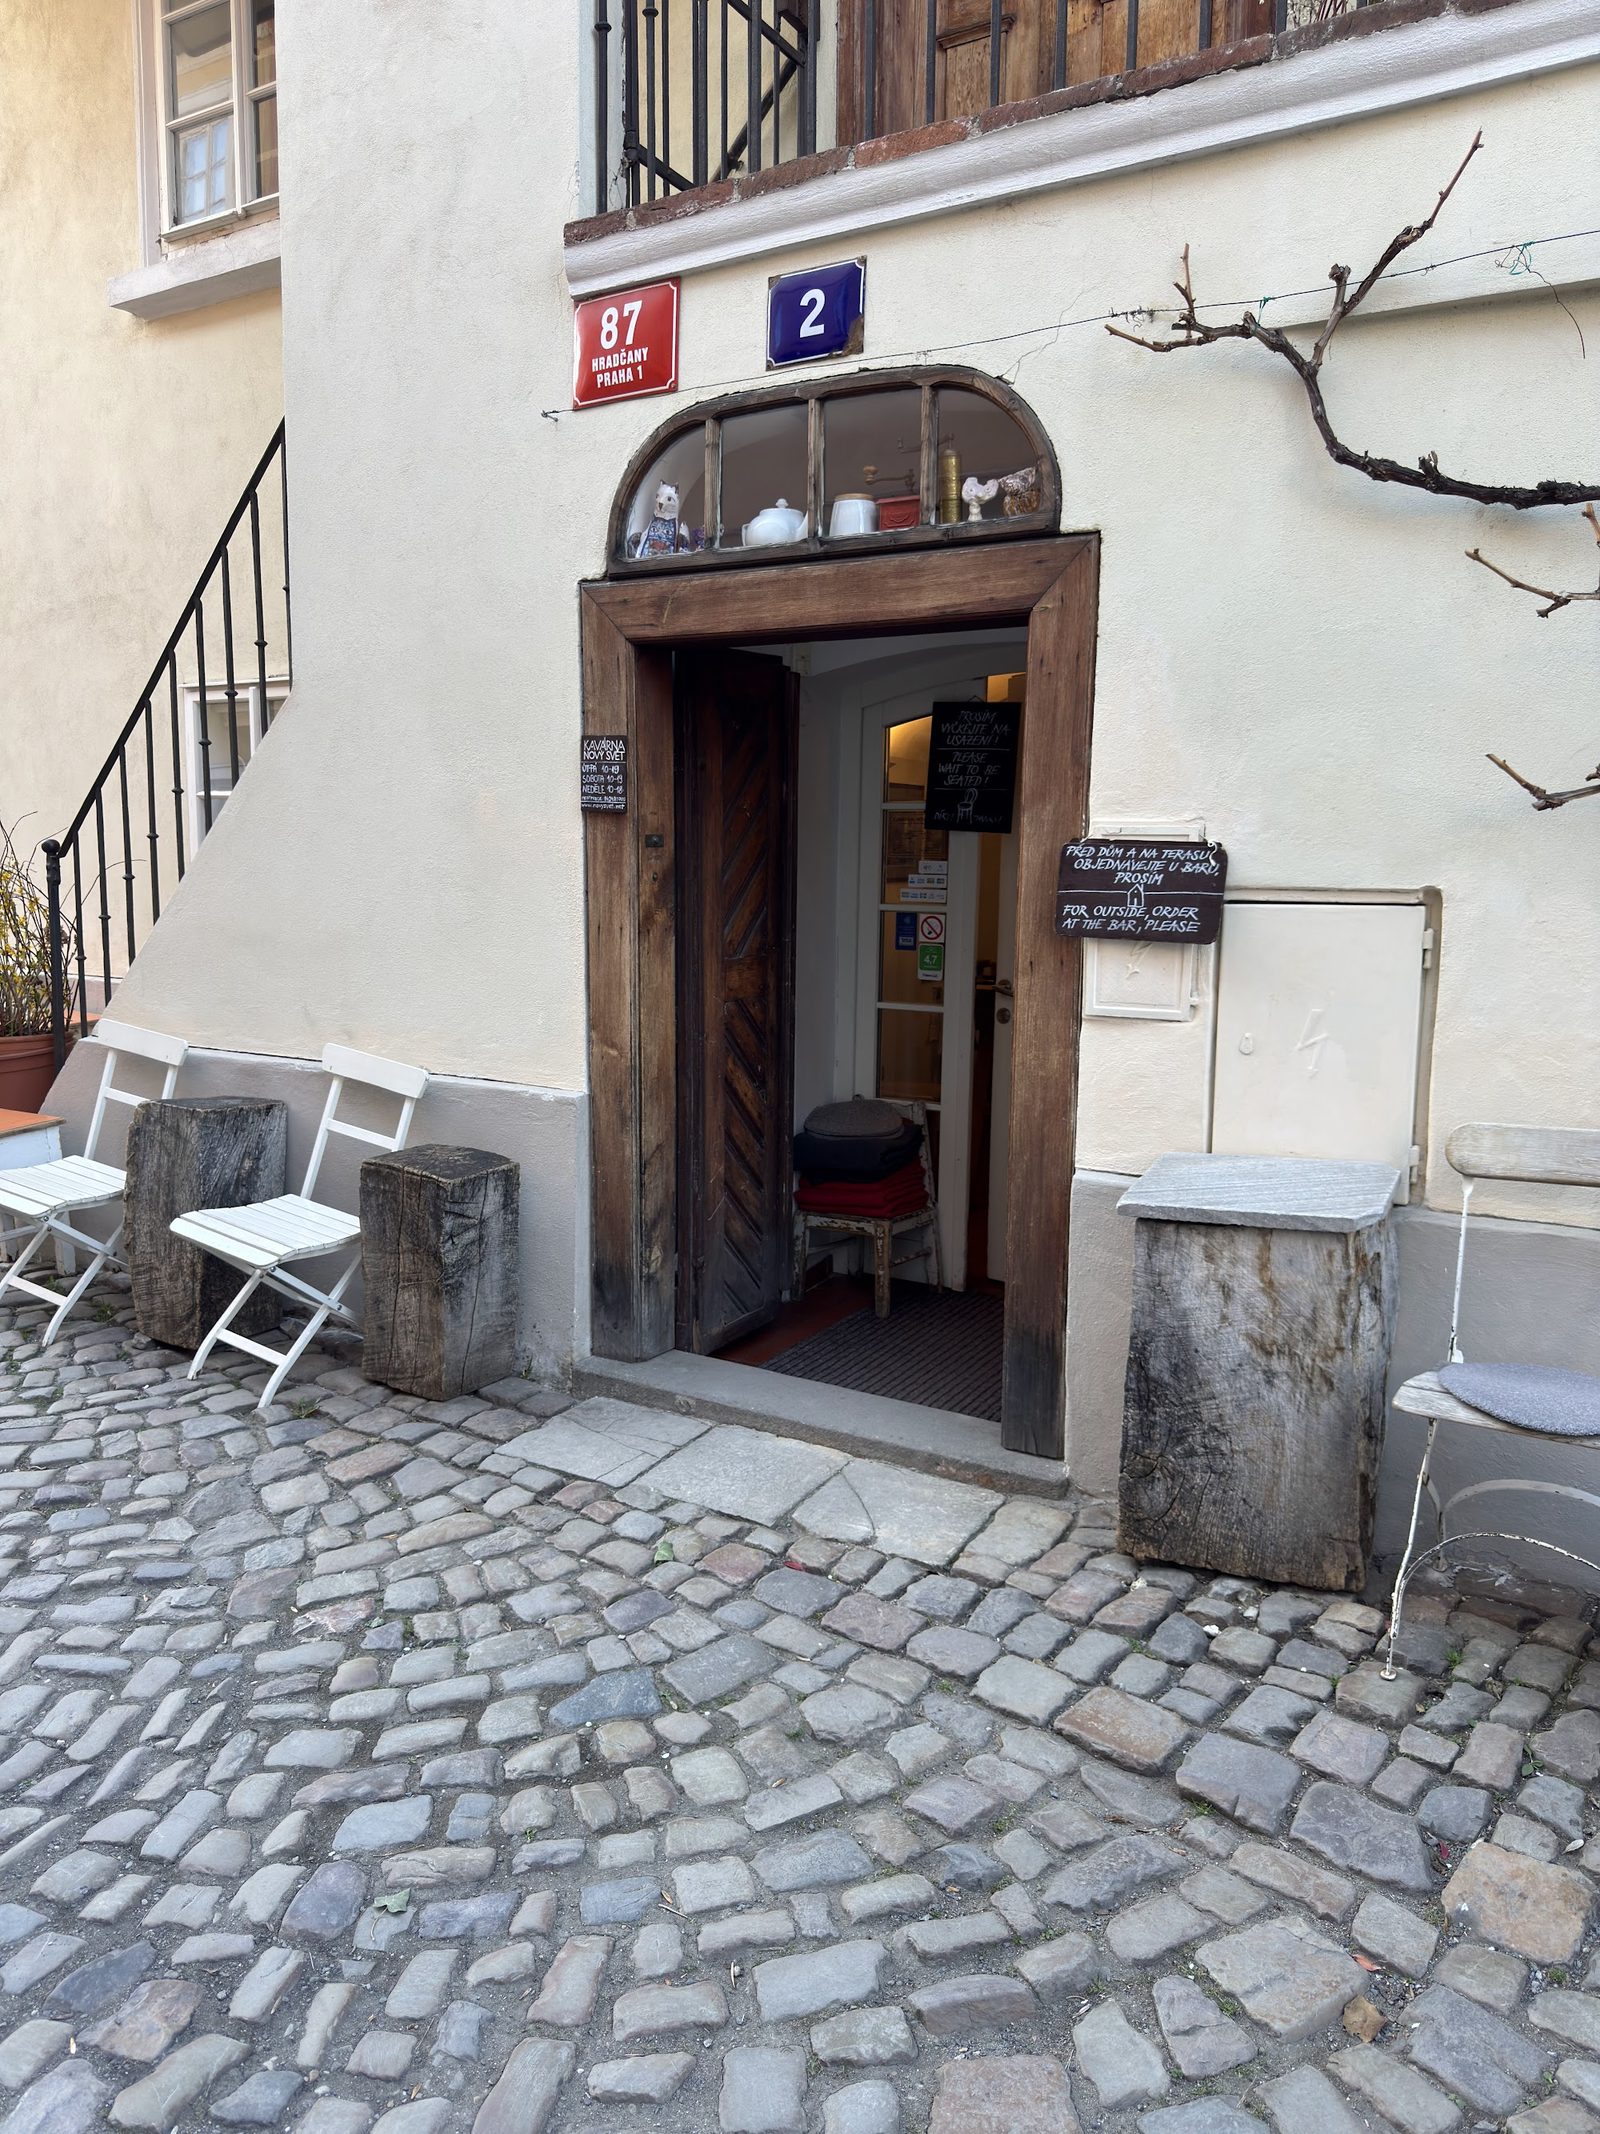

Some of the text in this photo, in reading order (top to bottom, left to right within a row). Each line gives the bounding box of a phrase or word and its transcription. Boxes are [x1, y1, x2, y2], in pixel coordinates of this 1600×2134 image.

[799, 288, 826, 338] 2
[600, 300, 643, 350] 87
[592, 347, 649, 373] HRADČANY
[597, 365, 643, 389] PRAHA 1
[959, 709, 997, 722] PROSÍM
[991, 723, 1012, 736] NA
[583, 737, 626, 752] KAVÁRNA
[583, 750, 605, 760] NOVÝ
[952, 751, 989, 763] PLEASE
[938, 762, 1001, 775] WAIT TO BE
[582, 774, 605, 783] SOBOTA
[582, 783, 606, 794] NEDĚLE
[1066, 844, 1210, 860] PŘED DŮM A NA TERASU
[1073, 858, 1167, 872] OBJEDNÁVEJTE
[1168, 862, 1179, 871] U
[1113, 871, 1164, 885] PROSÍM
[1062, 904, 1199, 920] FOR OUTSIDE, ORDER
[1061, 918, 1201, 934] AT THE BAR, PLEASE
